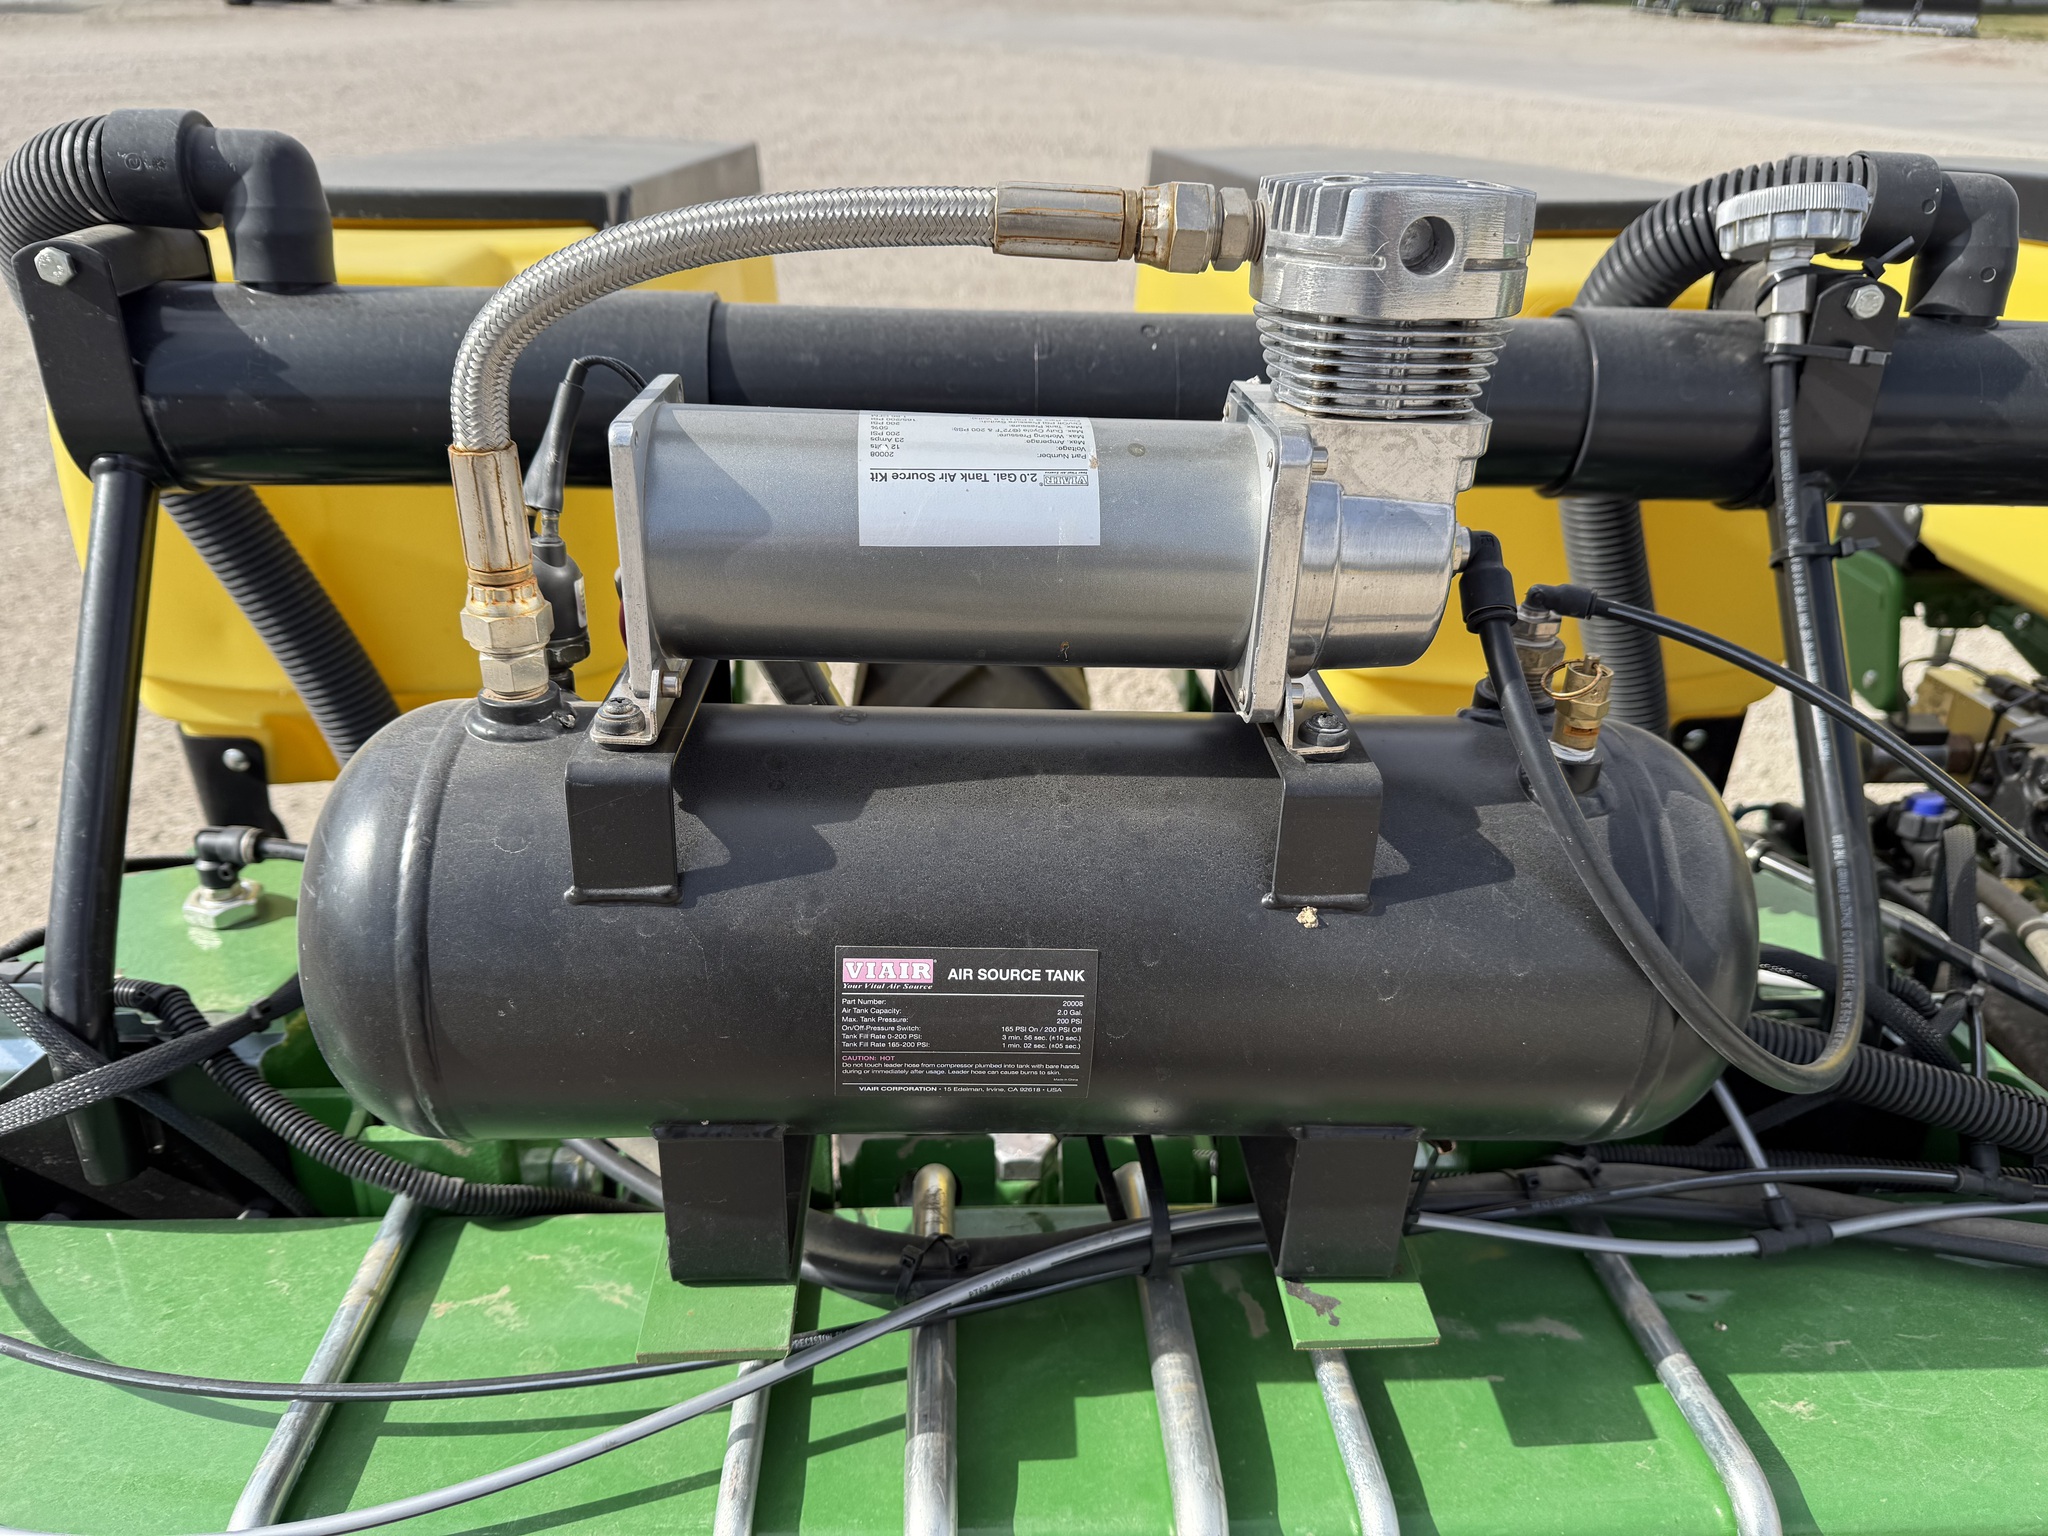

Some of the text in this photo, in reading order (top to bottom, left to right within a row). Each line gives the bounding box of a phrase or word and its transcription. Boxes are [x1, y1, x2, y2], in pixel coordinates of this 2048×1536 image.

[870, 472, 1037, 482] 2.0 Gal. Tank Air Source Kit
[1044, 476, 1088, 485] VIAIR
[845, 962, 931, 979] VIAIR
[948, 968, 1085, 981] AIR SOURCE TANK
